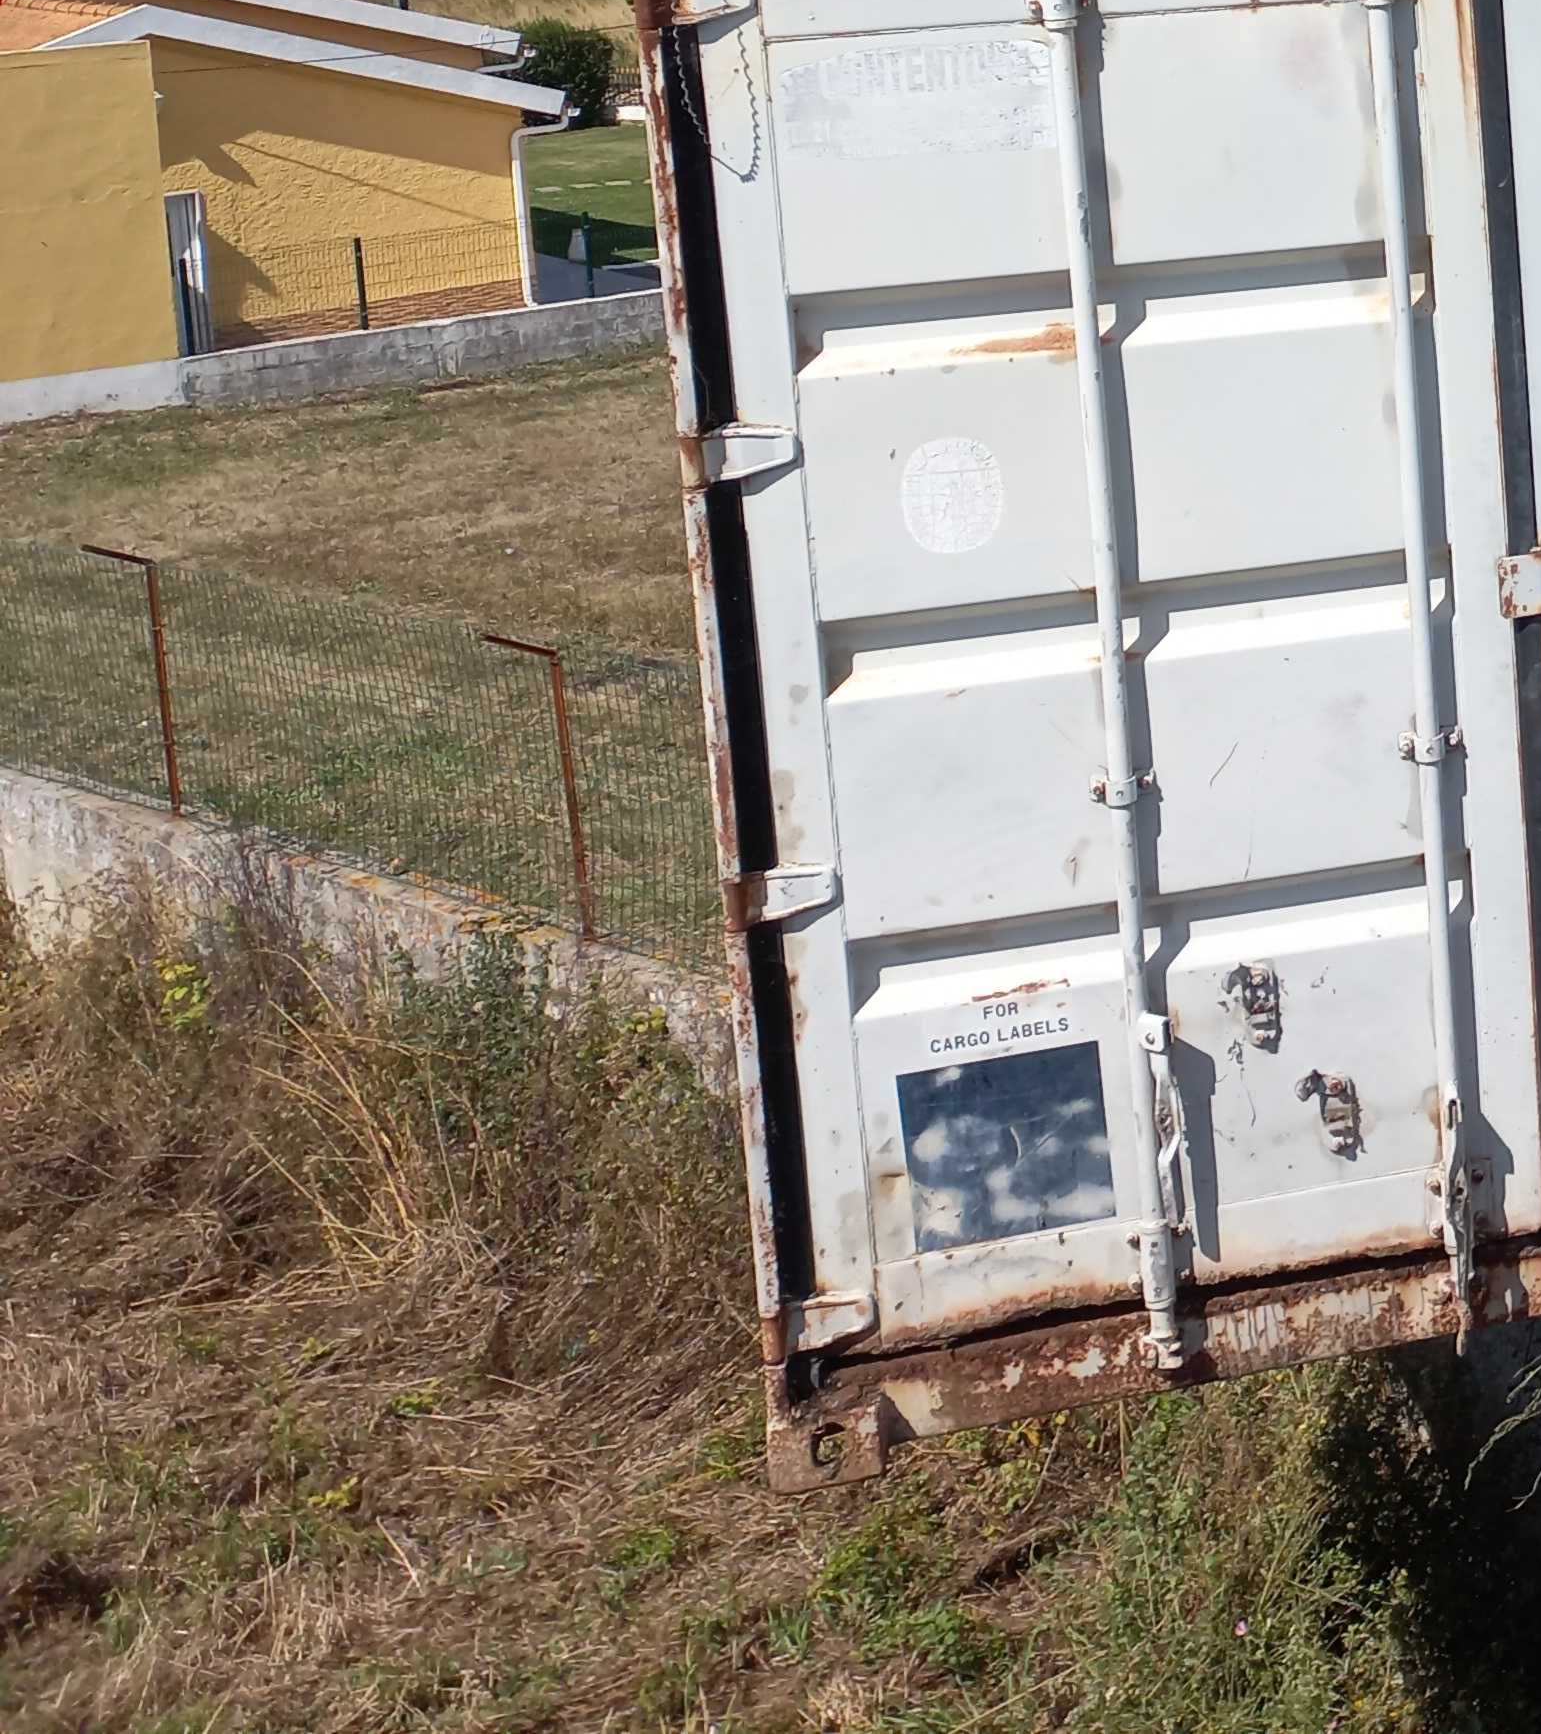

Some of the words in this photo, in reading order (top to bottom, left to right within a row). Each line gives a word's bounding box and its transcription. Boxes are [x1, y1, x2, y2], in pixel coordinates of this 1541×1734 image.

[982, 1001, 1019, 1020] FOR
[930, 1030, 991, 1053] CARGO
[996, 1017, 1069, 1042] LABELS
